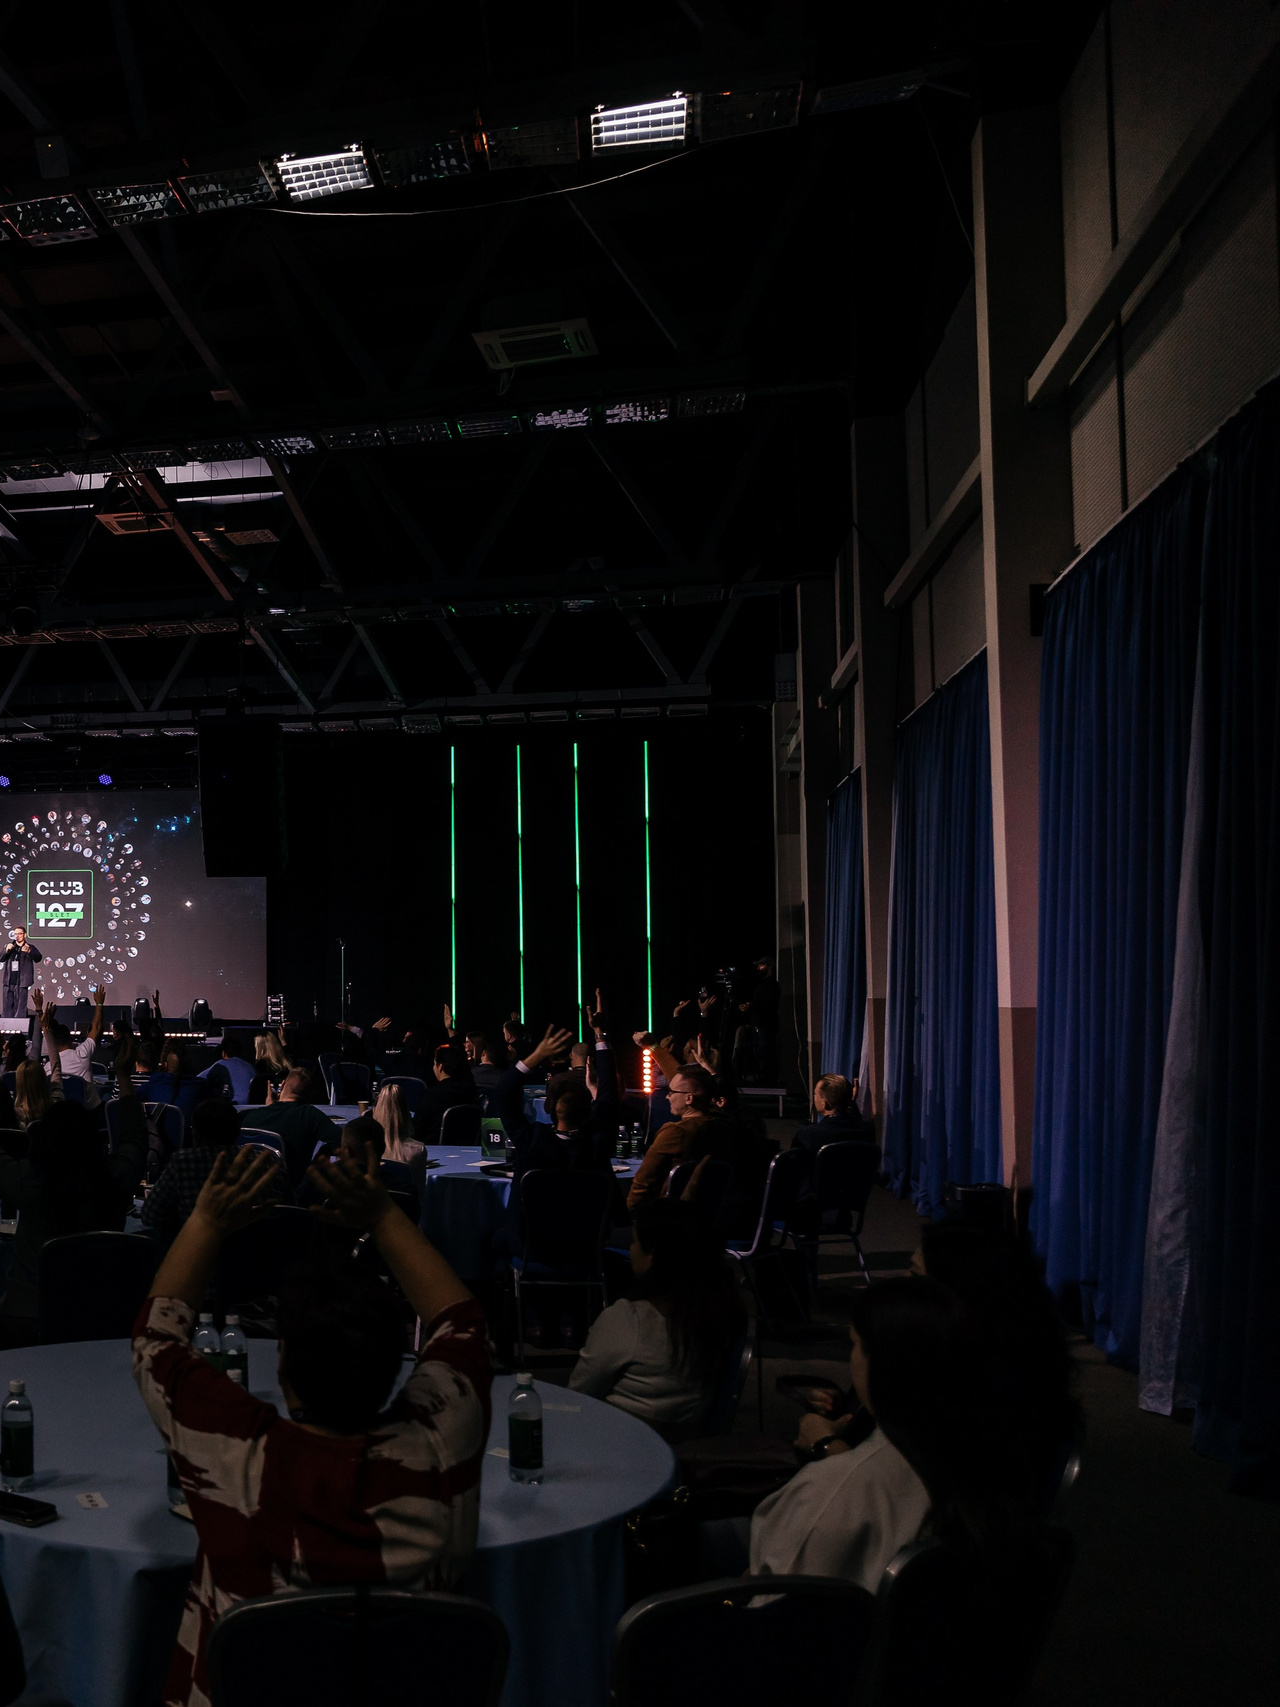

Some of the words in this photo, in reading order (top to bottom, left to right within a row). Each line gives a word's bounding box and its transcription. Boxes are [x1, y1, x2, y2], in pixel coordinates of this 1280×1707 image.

[36, 881, 84, 896] CLUB
[36, 902, 84, 927] 127
[489, 1133, 500, 1143] 18
